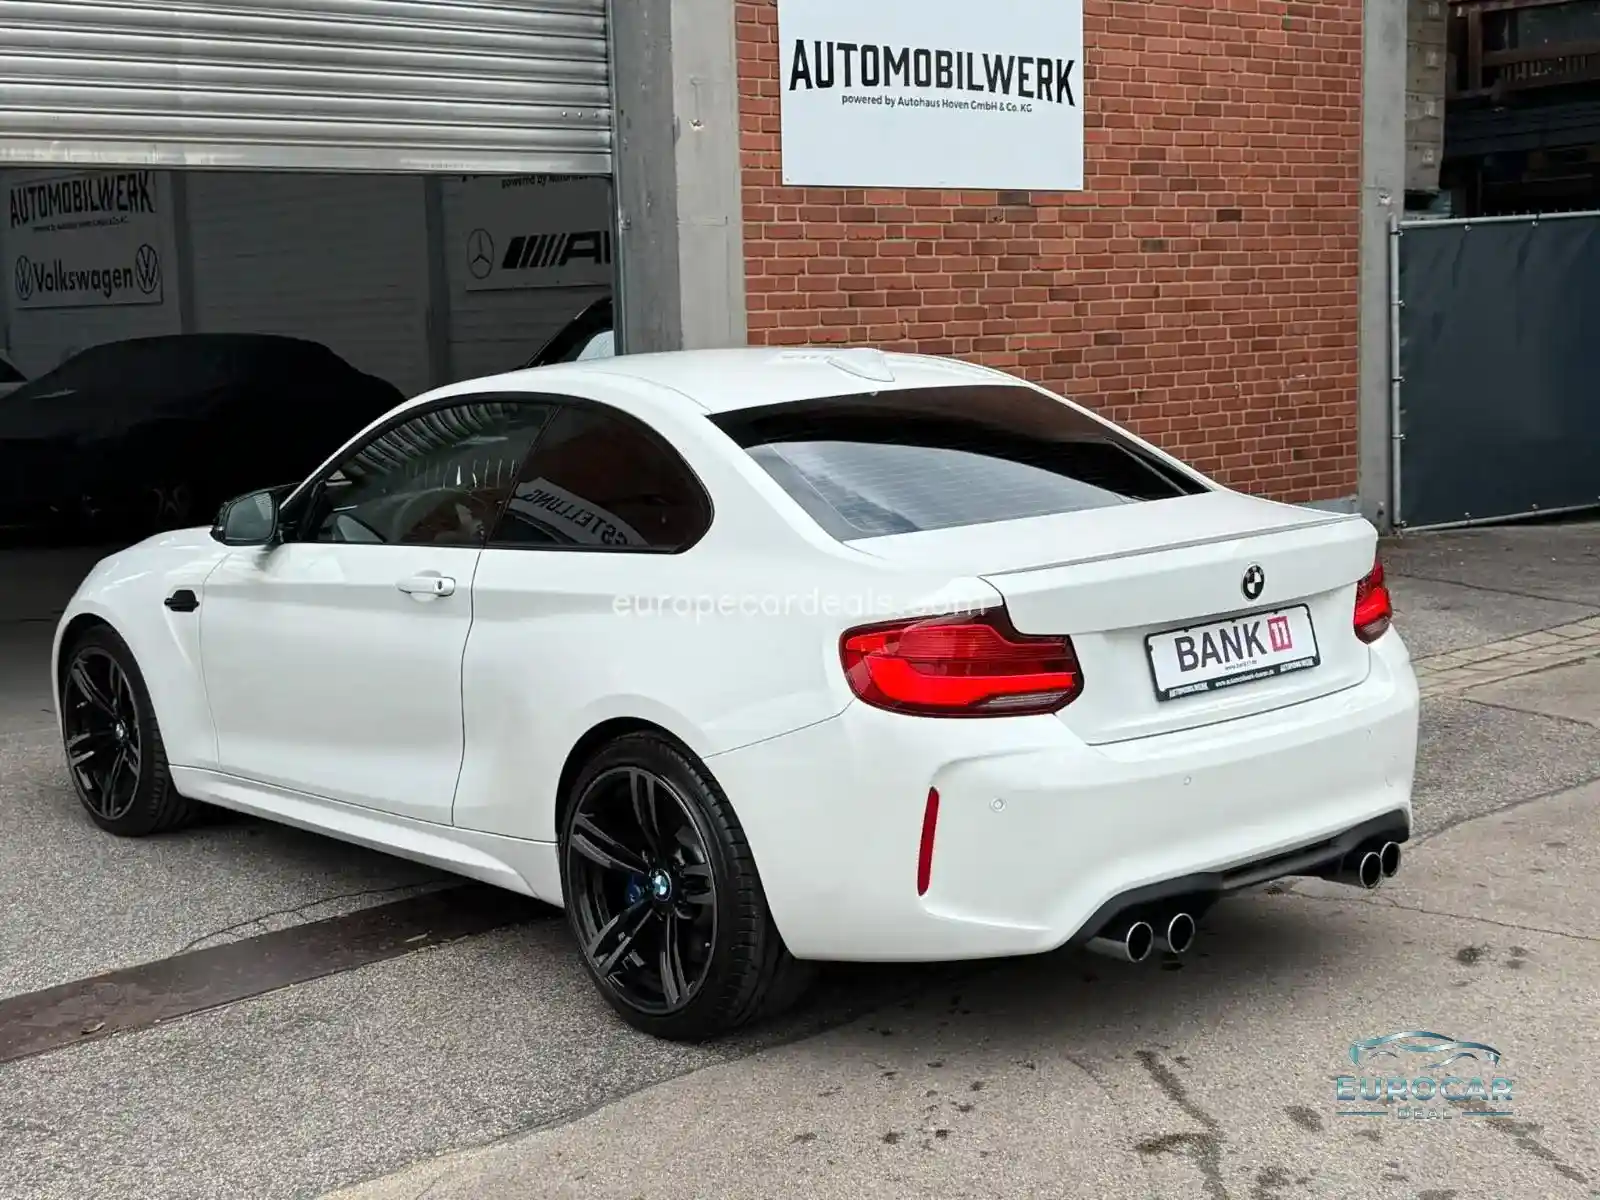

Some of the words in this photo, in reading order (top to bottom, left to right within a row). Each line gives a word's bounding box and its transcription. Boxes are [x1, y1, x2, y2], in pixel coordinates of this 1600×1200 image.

[789, 39, 1076, 107] AUTOMOBILWERK
[842, 95, 882, 106] powered
[884, 95, 896, 107] by
[897, 97, 940, 108] Autohaus
[942, 99, 969, 110] Hoven
[970, 101, 998, 111] GmbH
[999, 102, 1005, 112] &
[1006, 102, 1018, 112] Co.
[1020, 103, 1033, 112] KG
[10, 171, 155, 229] AUTOMOBILWERK
[33, 258, 134, 299] Volkswagen
[1174, 621, 1268, 673] BANK
